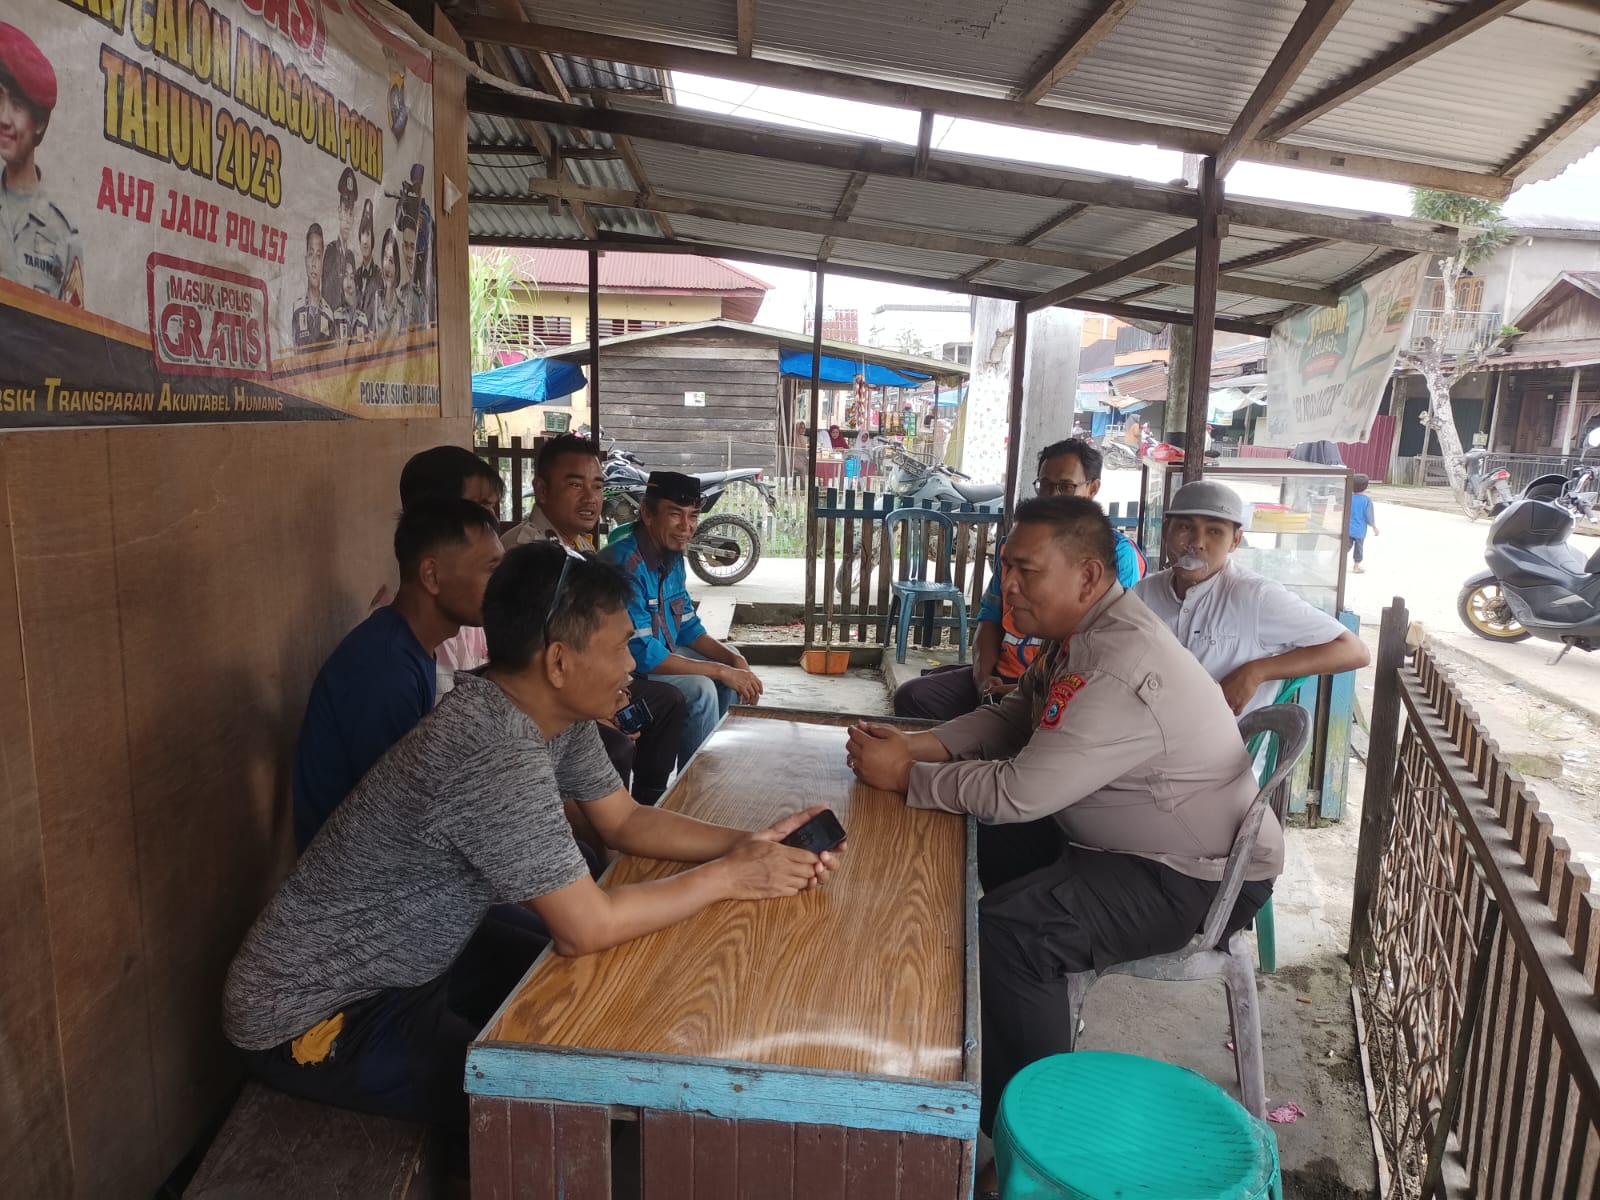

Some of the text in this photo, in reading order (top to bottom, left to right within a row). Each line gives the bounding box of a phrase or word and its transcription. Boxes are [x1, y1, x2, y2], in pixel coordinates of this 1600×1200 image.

[130, 0, 383, 185] CALON ANGGOTA POLRI
[100, 43, 281, 208] TAHUN 2023
[97, 167, 287, 264] AYO JADI POLISI
[167, 275, 253, 313] MASUK POLISI
[160, 303, 262, 364] GRATIS
[0, 377, 284, 412] SIH TRANSPARAN AKUNTABEL HUMANIS
[360, 381, 389, 405] POLSEK
